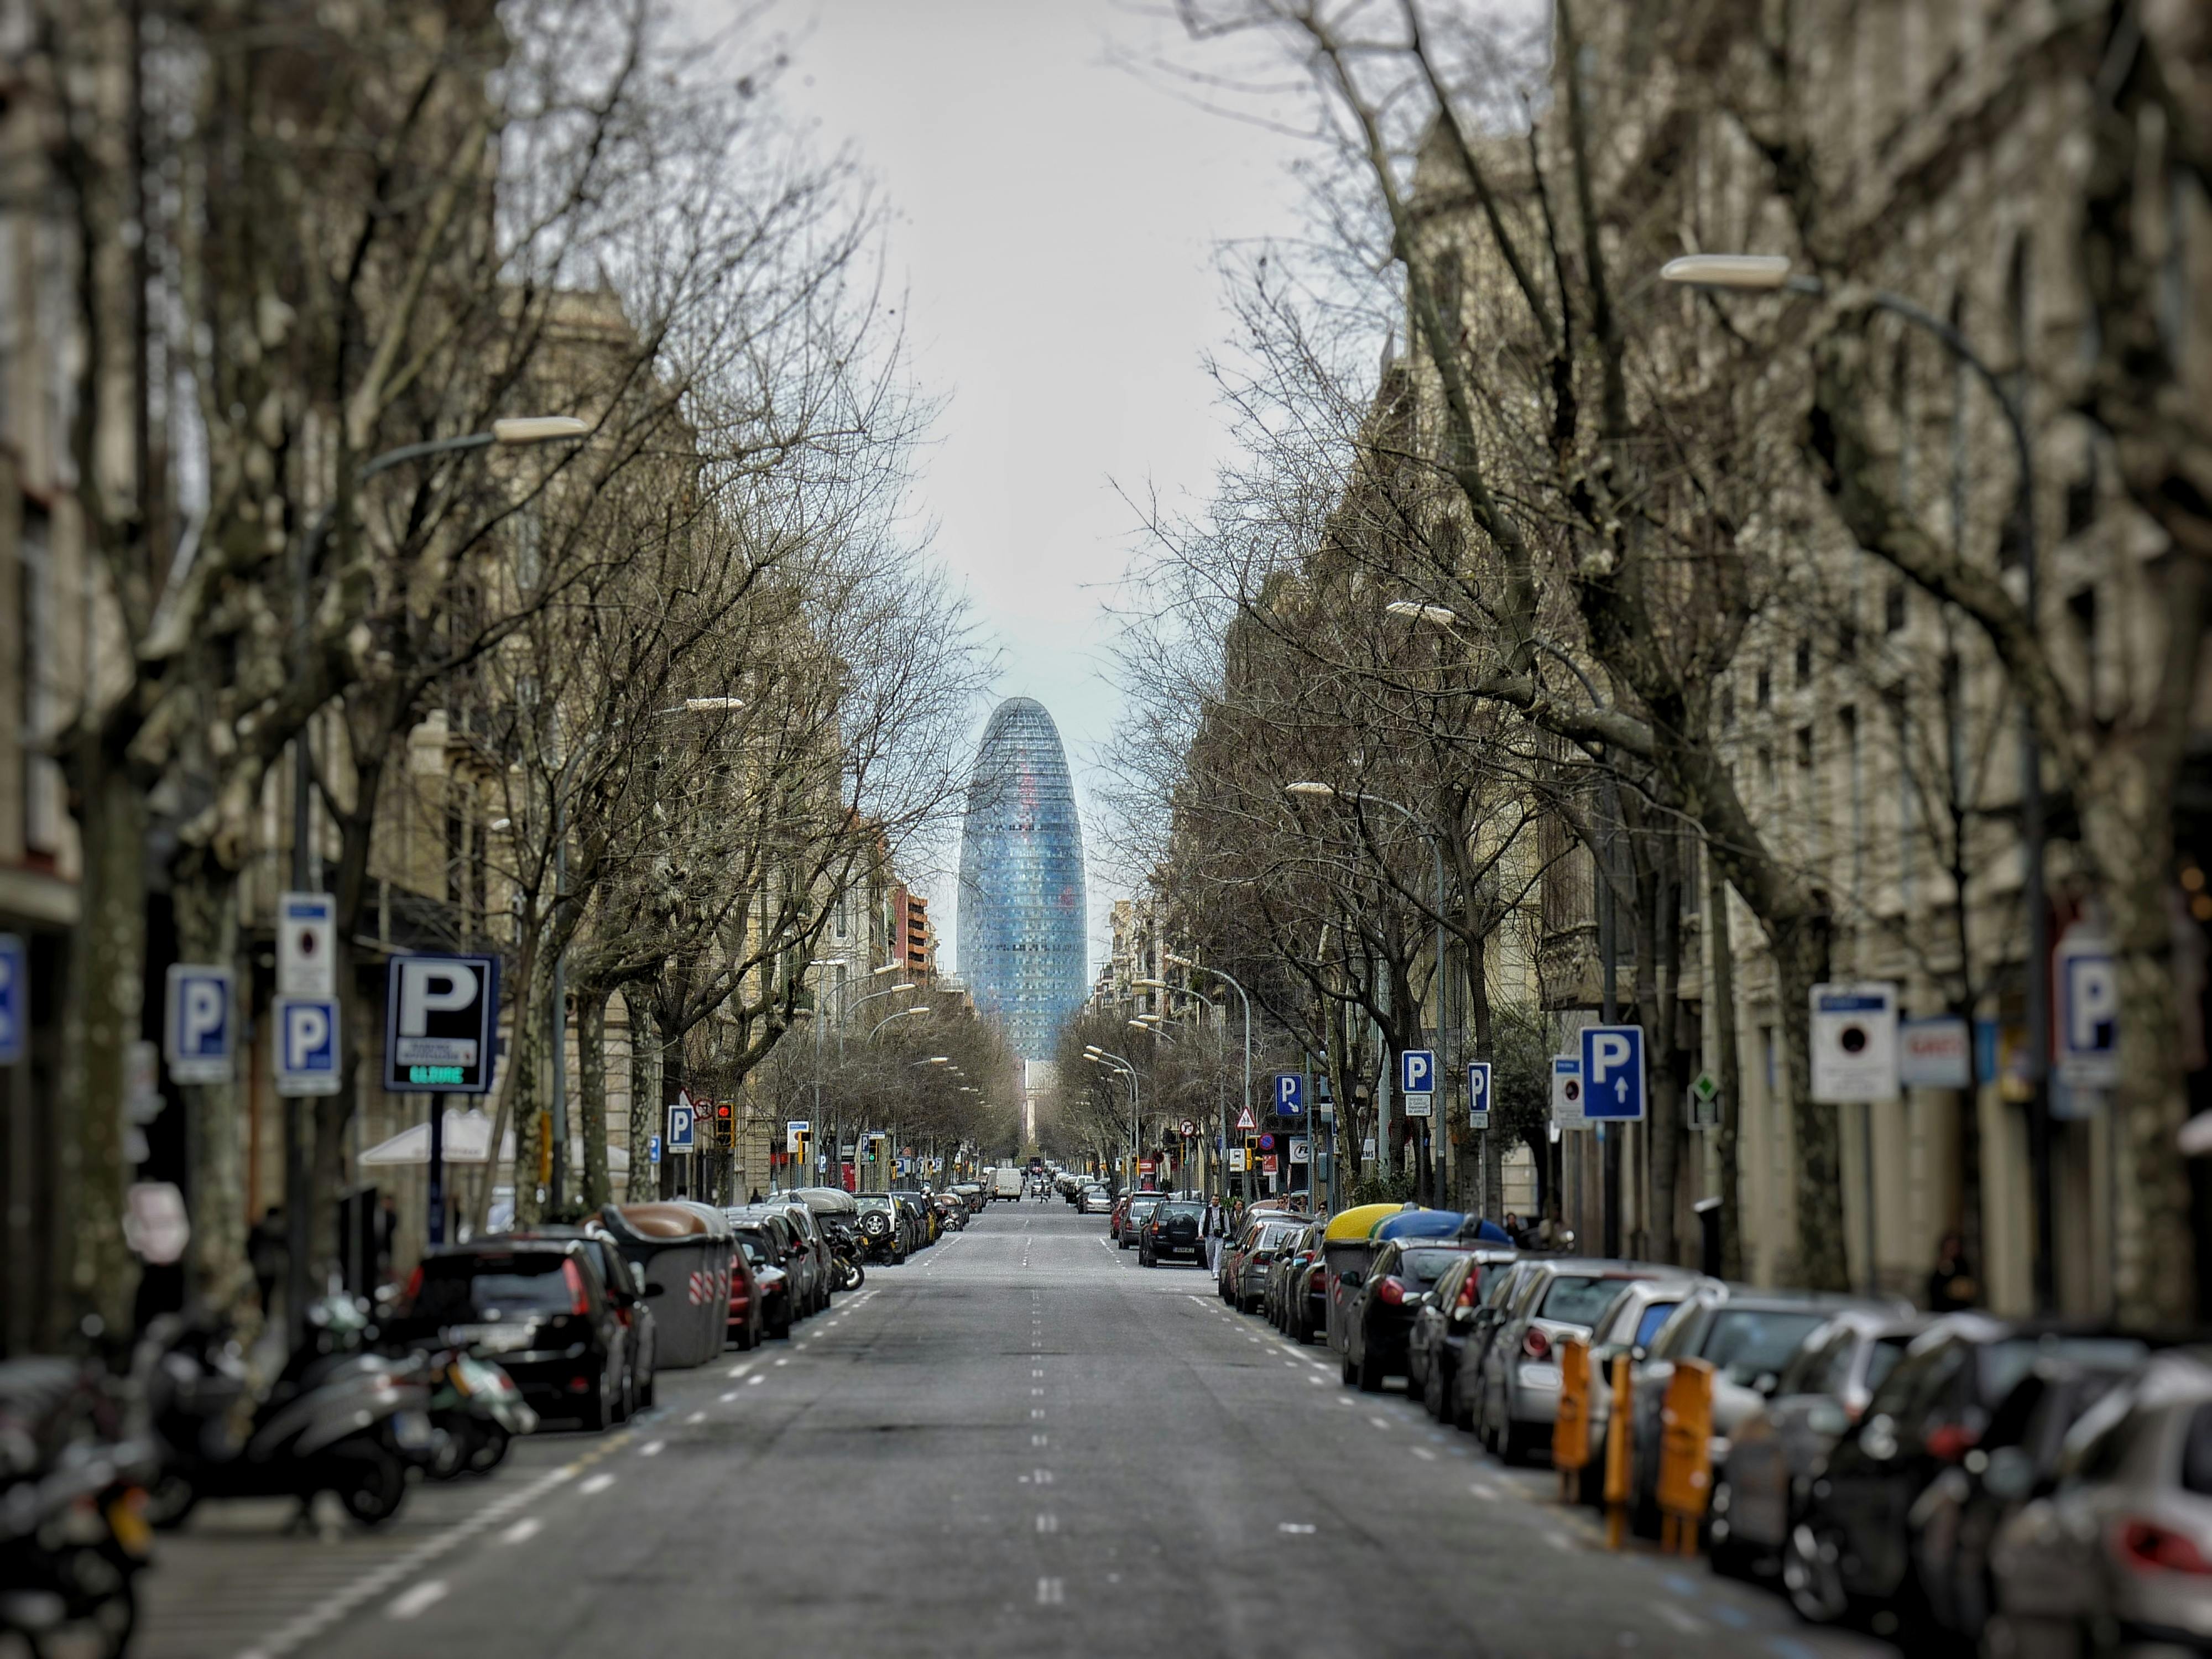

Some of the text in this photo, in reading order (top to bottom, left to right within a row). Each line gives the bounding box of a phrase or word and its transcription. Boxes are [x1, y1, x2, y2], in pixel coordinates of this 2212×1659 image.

[399, 962, 478, 1037] P
[2073, 960, 2117, 1046] P
[182, 980, 224, 1057] P
[289, 1008, 327, 1070] P
[1408, 1056, 1427, 1088] P
[1592, 1033, 1631, 1083] P
[1282, 1078, 1296, 1102] P
[1472, 1070, 1484, 1107] P
[674, 1112, 688, 1141] P
[863, 1136, 868, 1150] P
[821, 1155, 826, 1167] P
